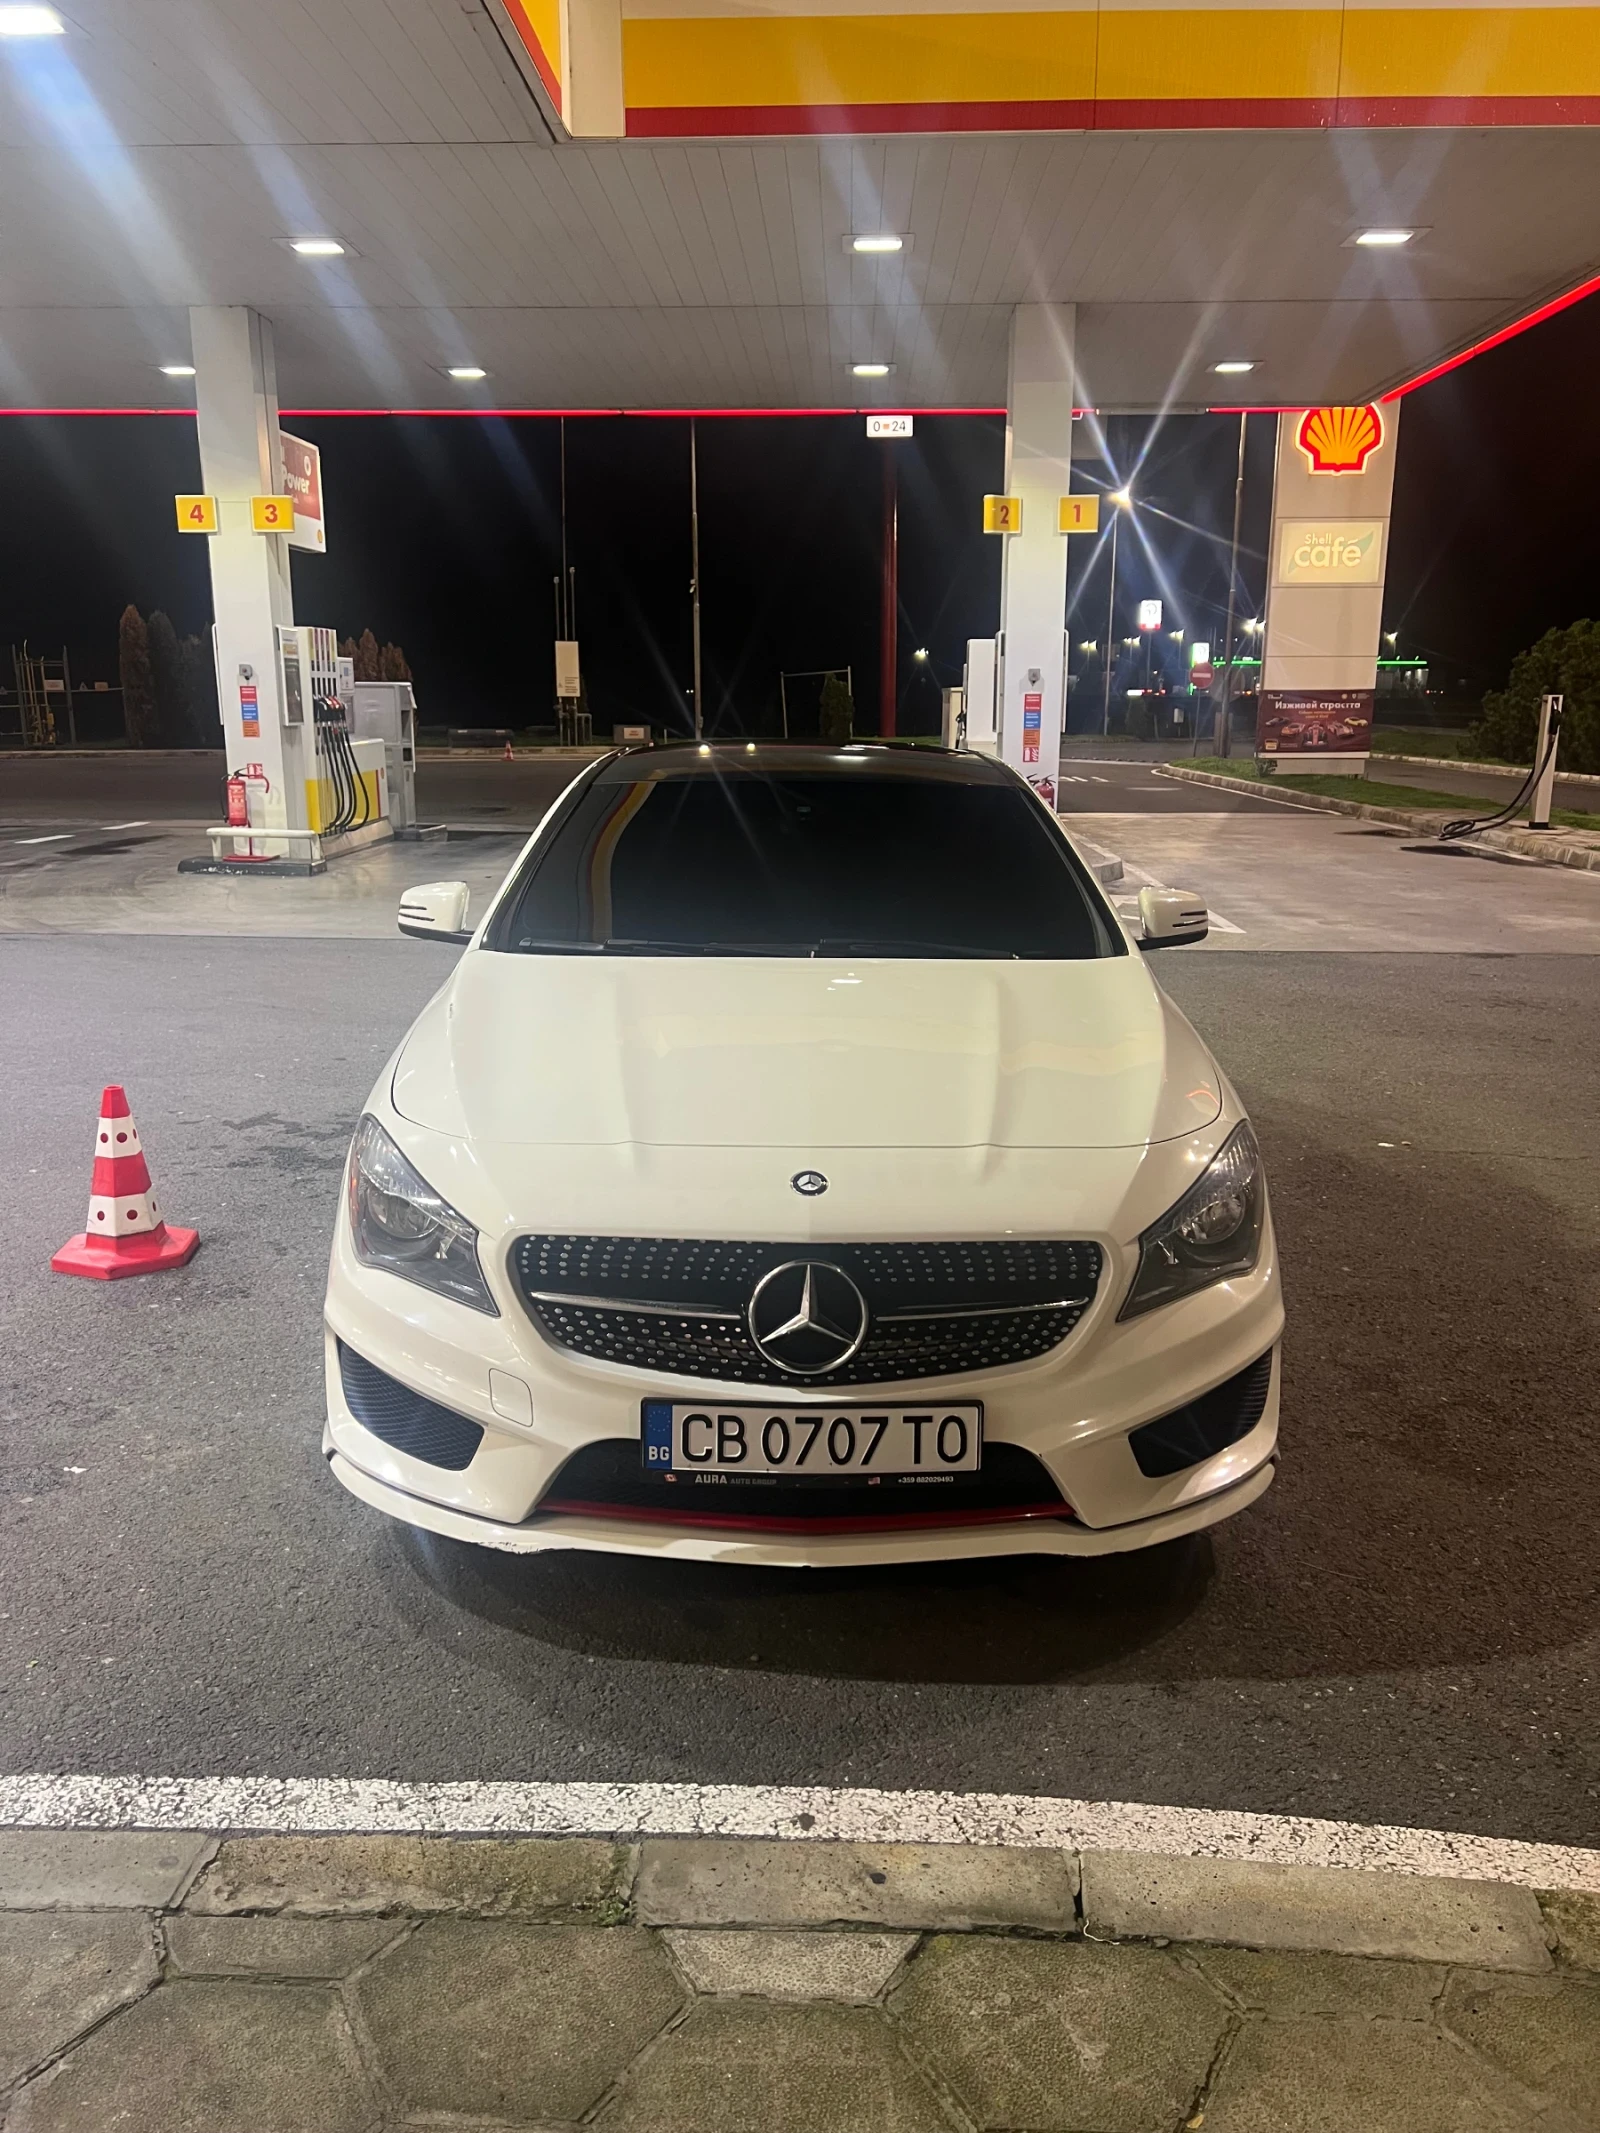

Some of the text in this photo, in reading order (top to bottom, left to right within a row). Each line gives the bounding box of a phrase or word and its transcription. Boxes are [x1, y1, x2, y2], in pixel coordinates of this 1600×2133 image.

[189, 504, 204, 523] 4
[264, 504, 278, 523] 3
[1000, 505, 1009, 525] 2
[1073, 504, 1081, 522] 1
[1304, 533, 1332, 545] Shell
[1294, 536, 1361, 567] café
[1275, 700, 1317, 709] Изживей
[761, 1416, 889, 1466] 0707
[648, 1446, 670, 1460] BG
[694, 1474, 728, 1484] AURA
